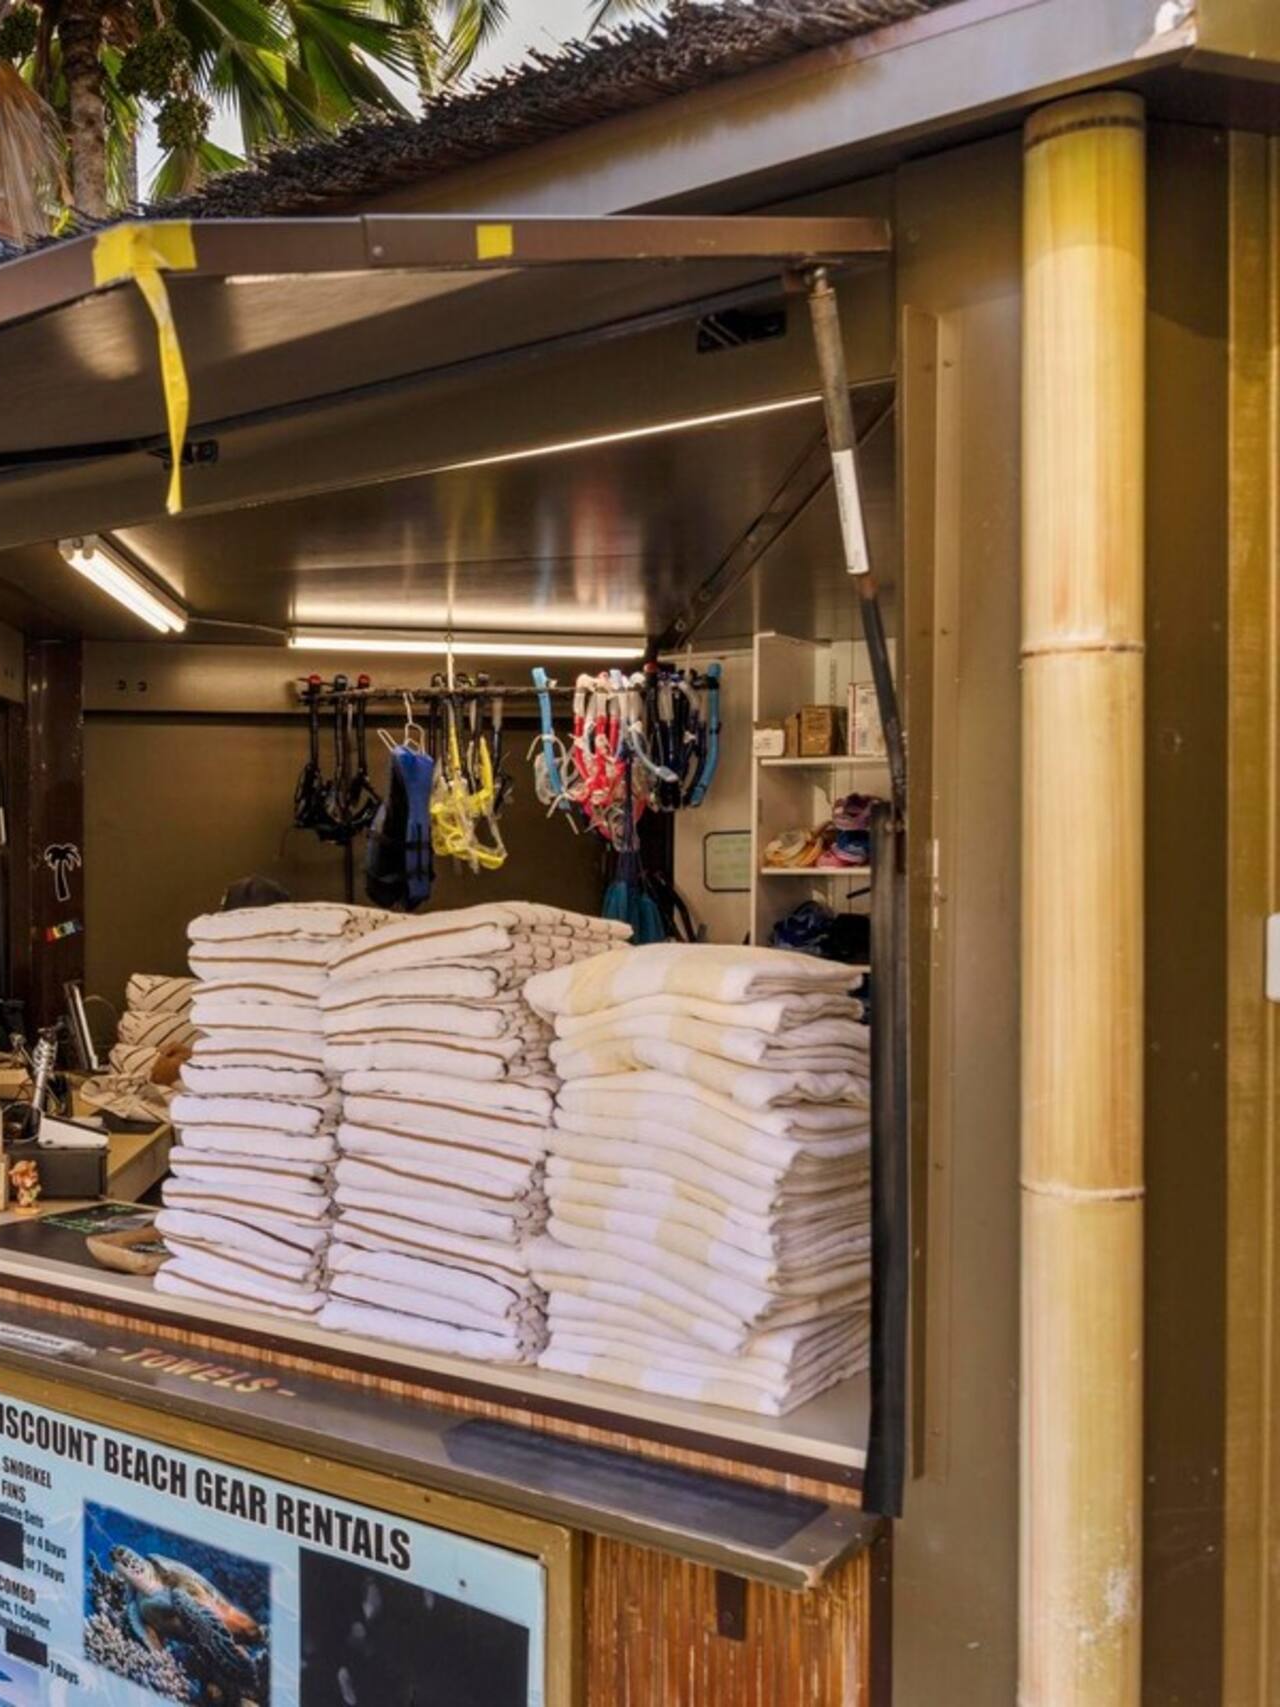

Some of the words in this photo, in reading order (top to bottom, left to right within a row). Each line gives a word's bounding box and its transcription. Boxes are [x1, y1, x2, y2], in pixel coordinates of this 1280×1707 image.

[2, 1456, 52, 1489] SNORKEL
[1, 1479, 26, 1503] FINS
[104, 1438, 187, 1499] BEACH
[195, 1467, 267, 1525] GEAR
[276, 1493, 411, 1571] RENTALS
[24, 1509, 44, 1529] Sets
[44, 1538, 67, 1559] Days
[43, 1561, 65, 1583] Days
[56, 1662, 80, 1686] Days
